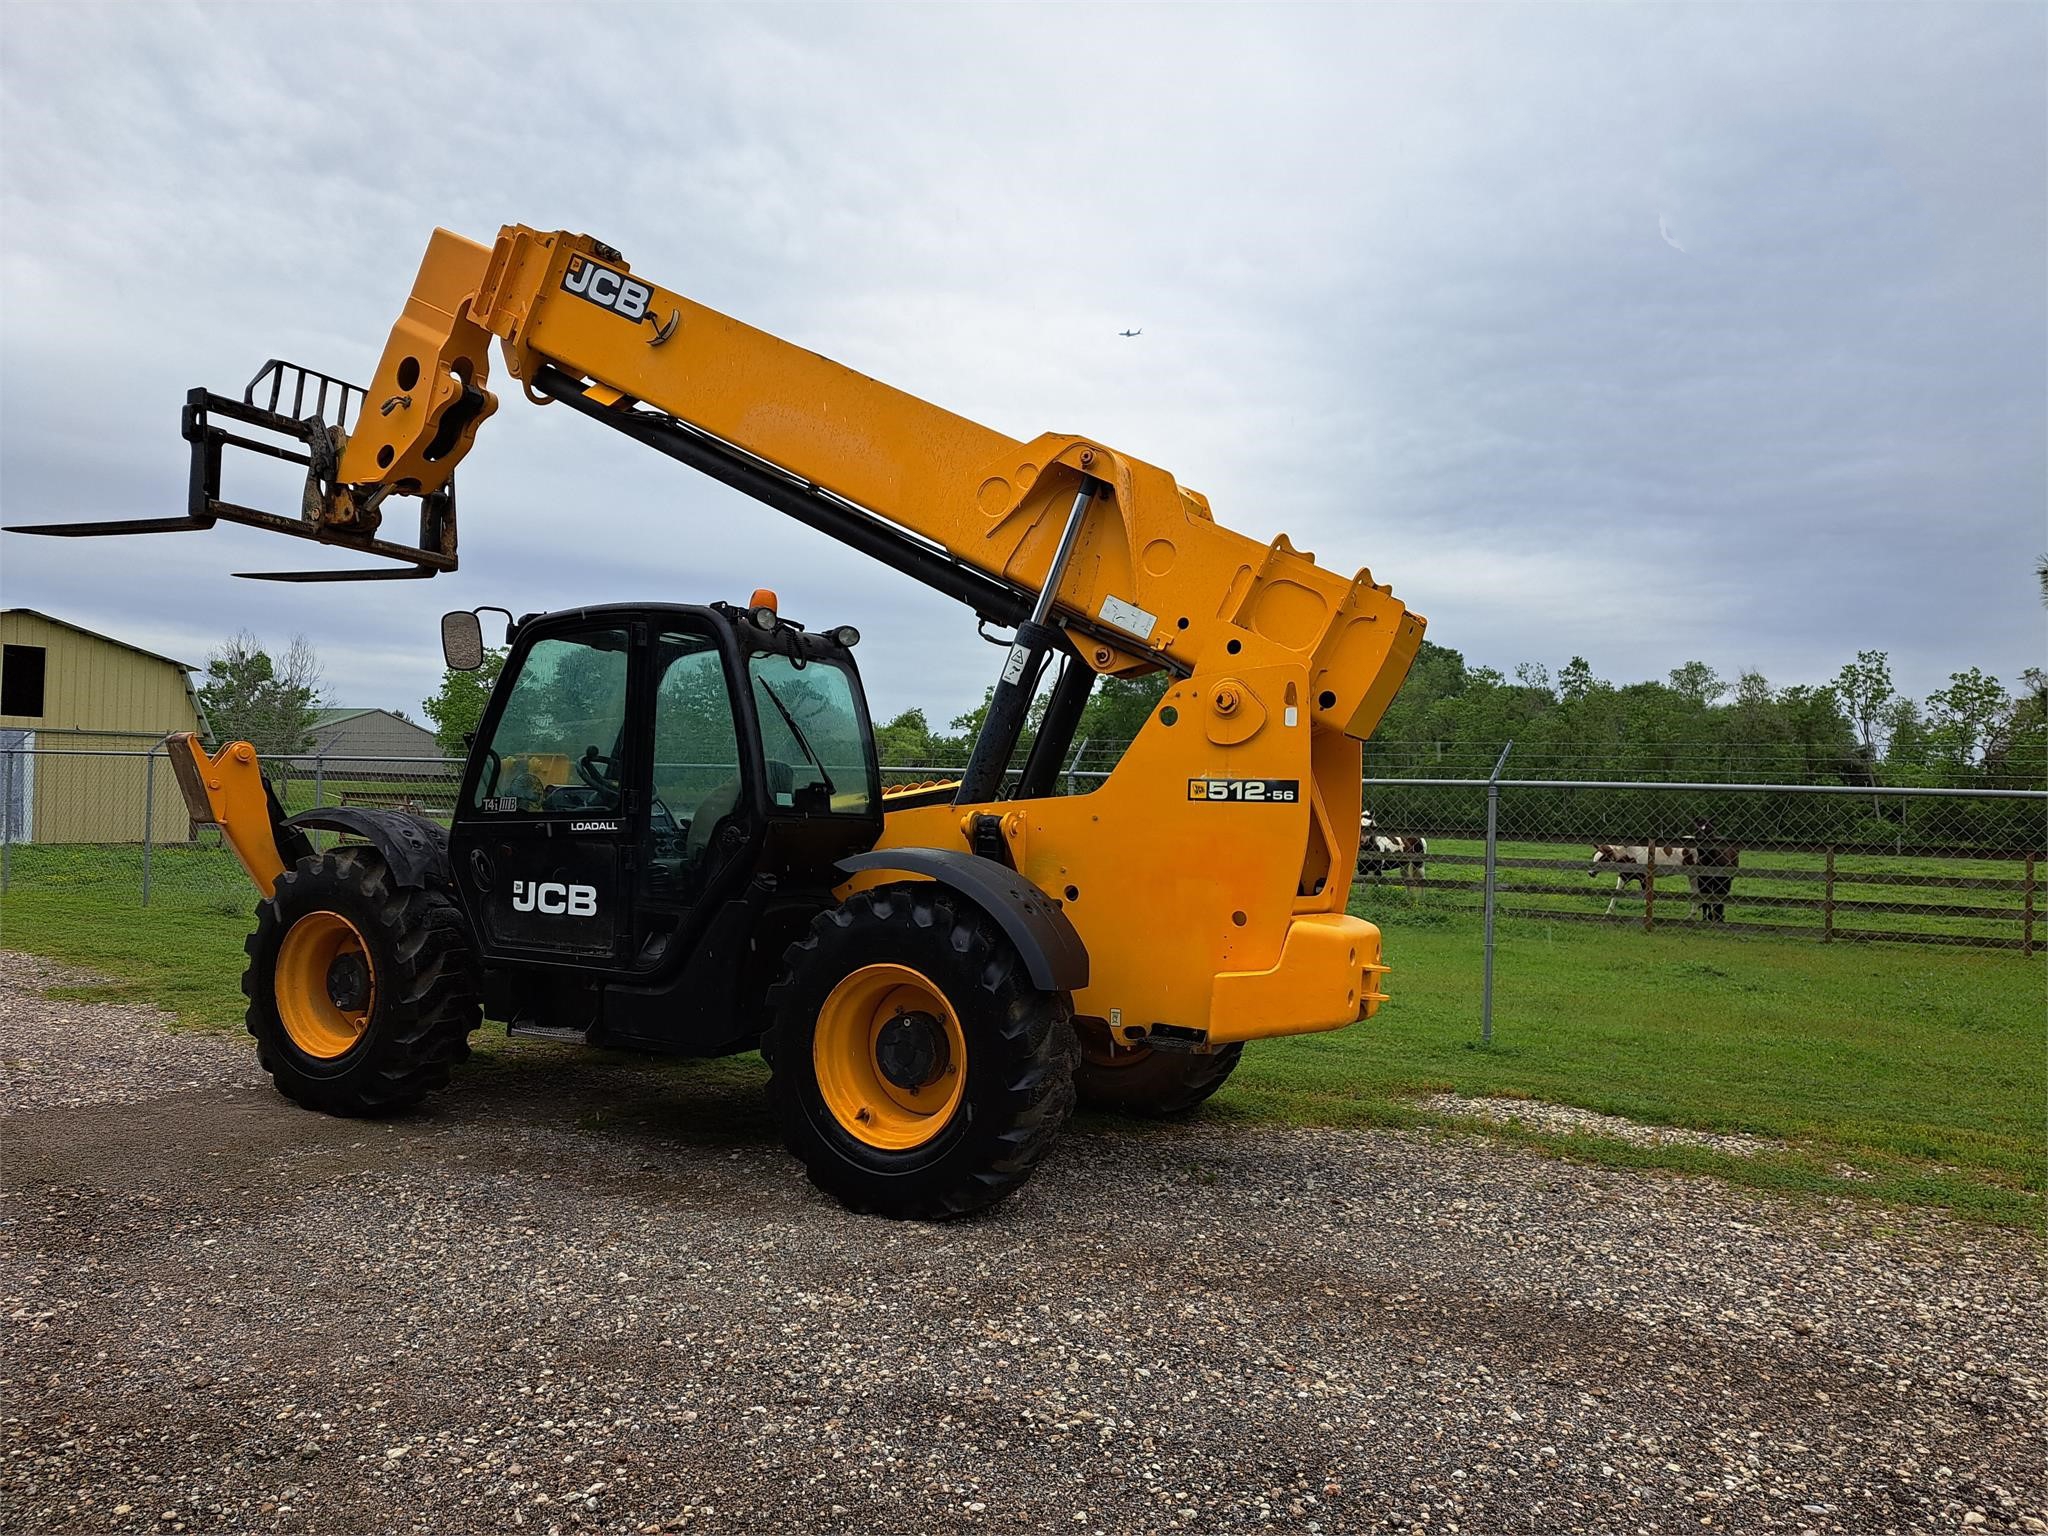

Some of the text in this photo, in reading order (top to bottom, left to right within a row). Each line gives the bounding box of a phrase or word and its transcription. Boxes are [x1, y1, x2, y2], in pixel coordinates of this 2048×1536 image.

[565, 262, 649, 319] JCB
[1208, 781, 1294, 801] 512-56
[570, 822, 618, 831] LOADALL
[512, 881, 597, 917] JCB
